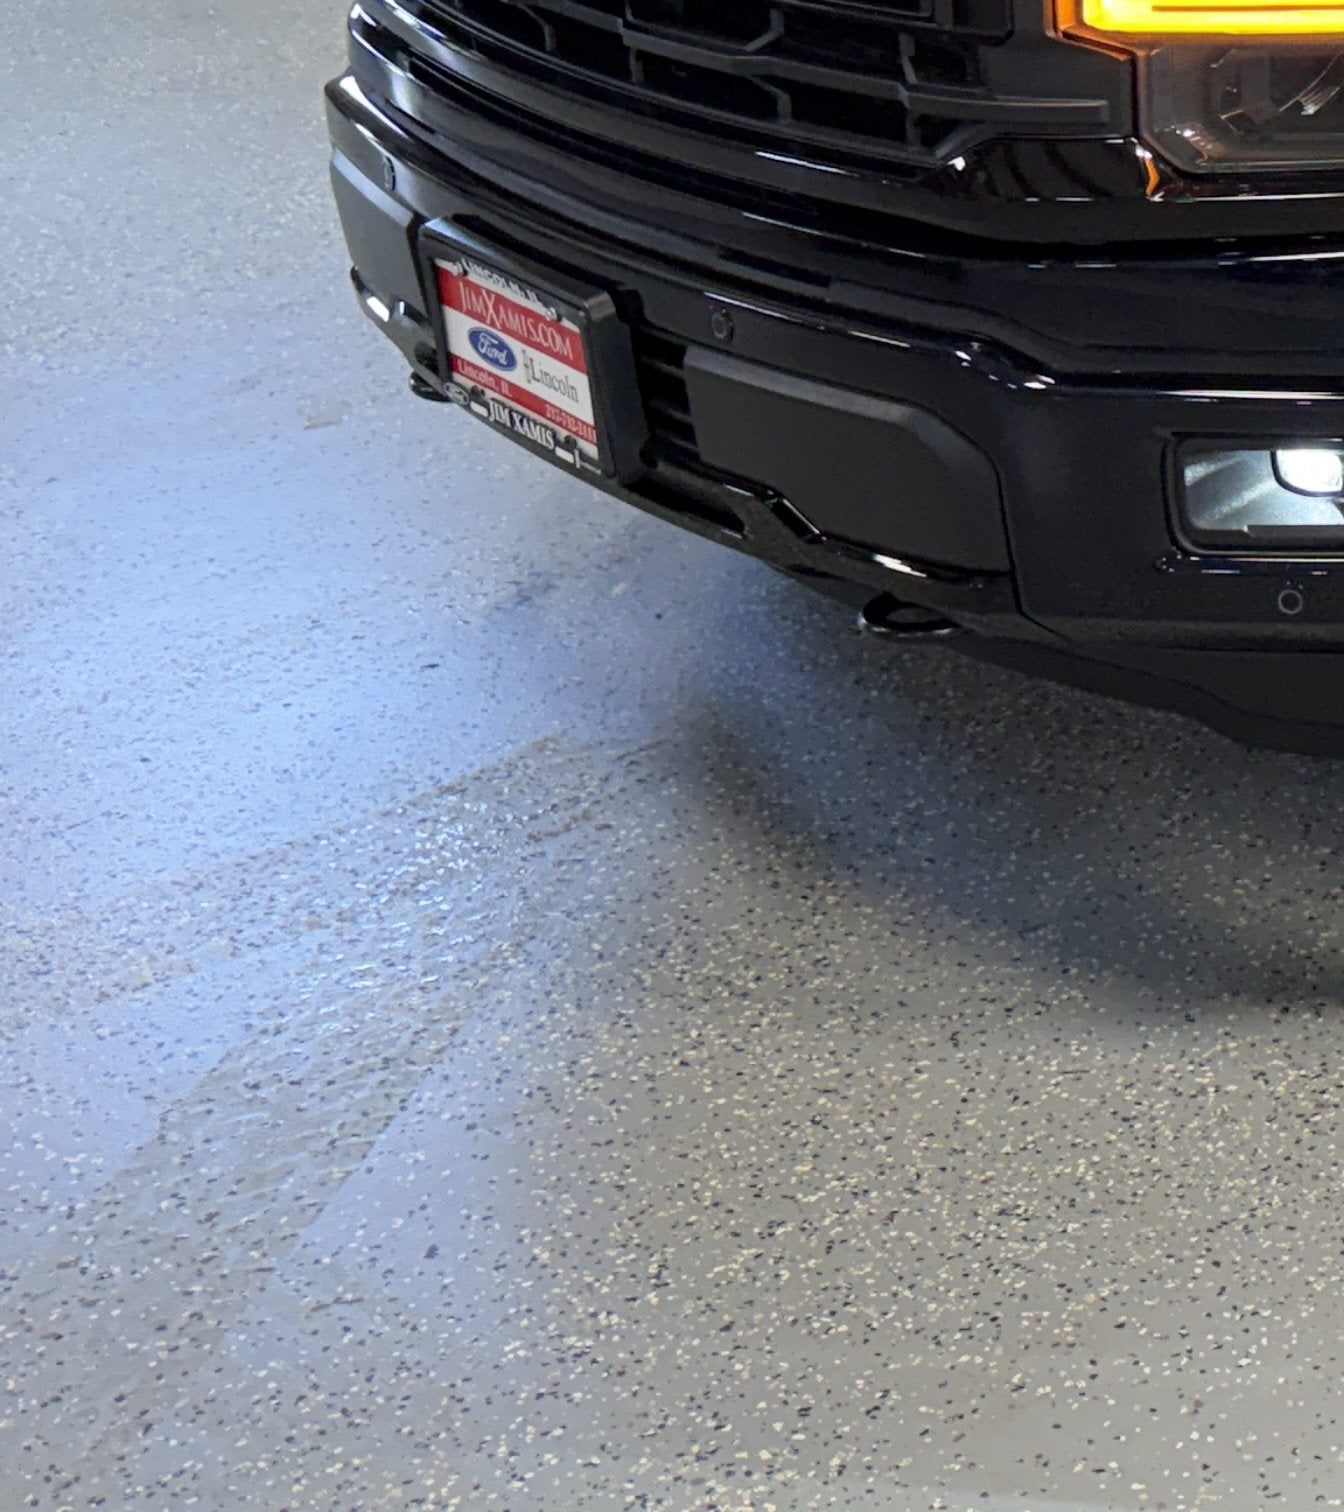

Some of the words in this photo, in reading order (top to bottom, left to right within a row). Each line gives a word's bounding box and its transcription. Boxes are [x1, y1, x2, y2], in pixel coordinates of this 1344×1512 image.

[477, 332, 509, 366] Ford
[489, 399, 511, 428] JIM
[512, 410, 556, 450] XAMIS
